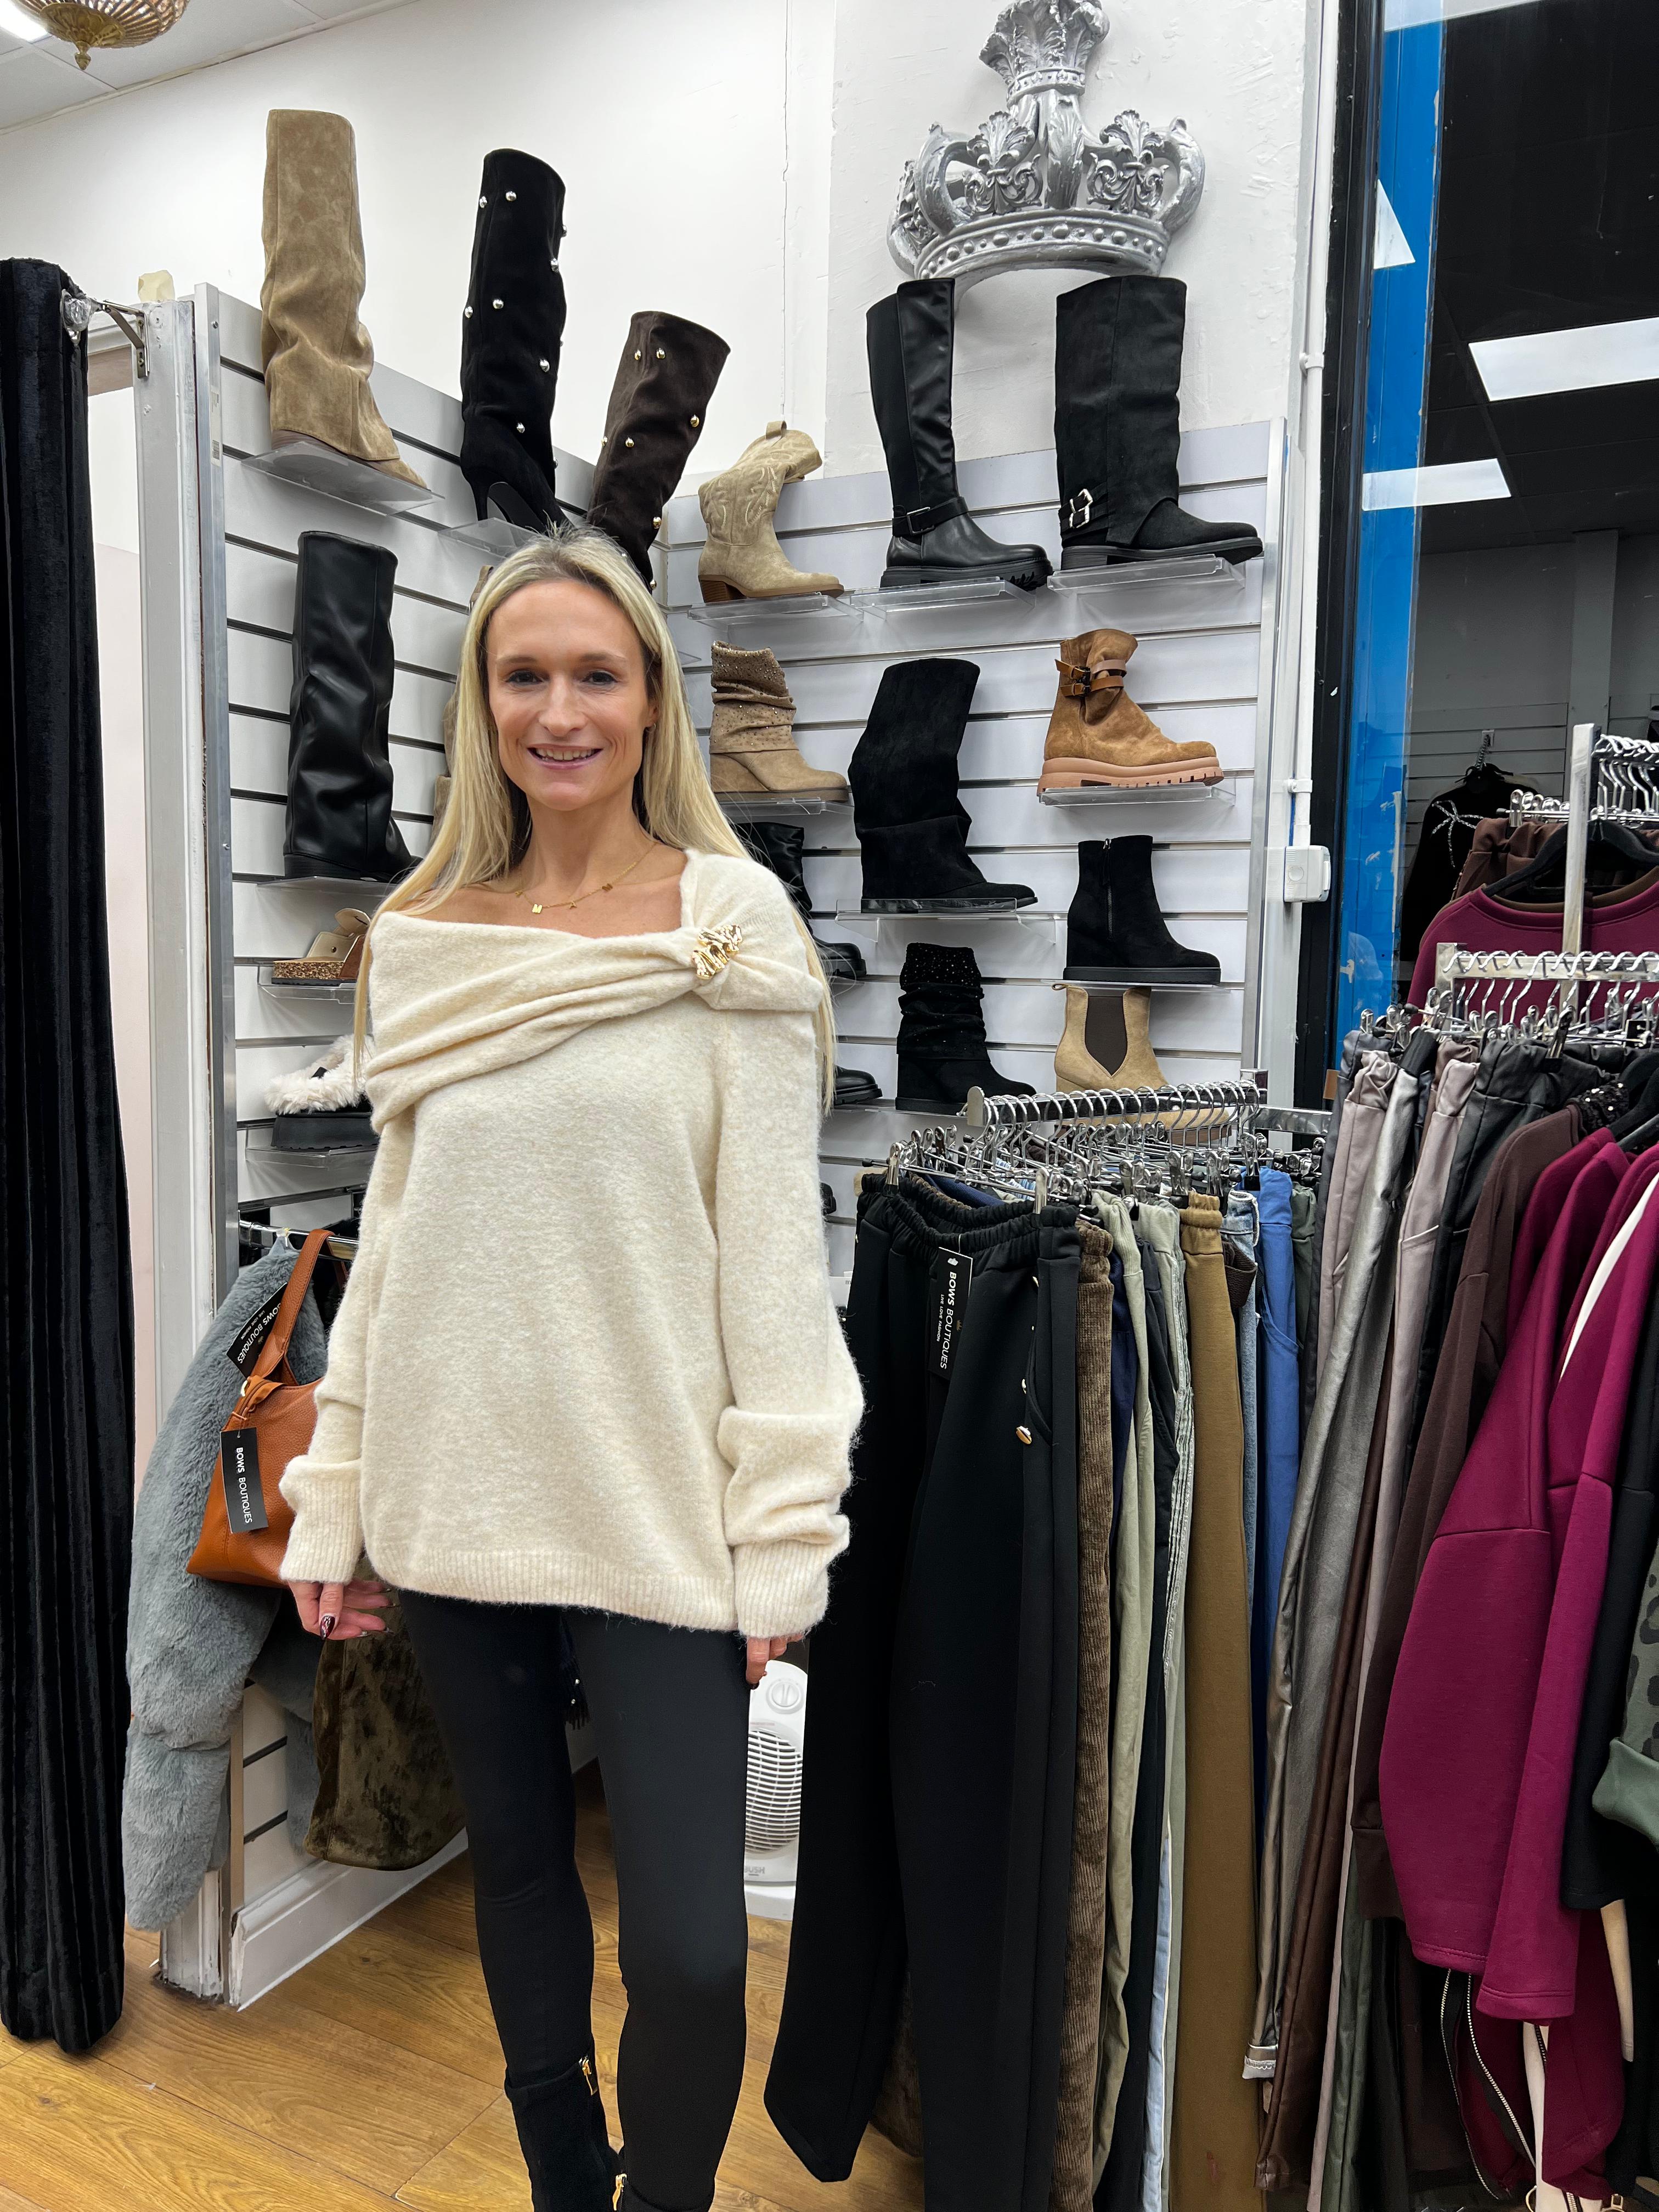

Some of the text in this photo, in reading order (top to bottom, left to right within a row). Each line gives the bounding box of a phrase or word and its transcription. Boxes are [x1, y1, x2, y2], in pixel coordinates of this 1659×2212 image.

[237, 1323, 263, 1364] BOUTIQUES
[940, 1271, 957, 1369] BOWS BOUTIQUES
[236, 1447, 253, 1523] BOWS BOUTIQUES
